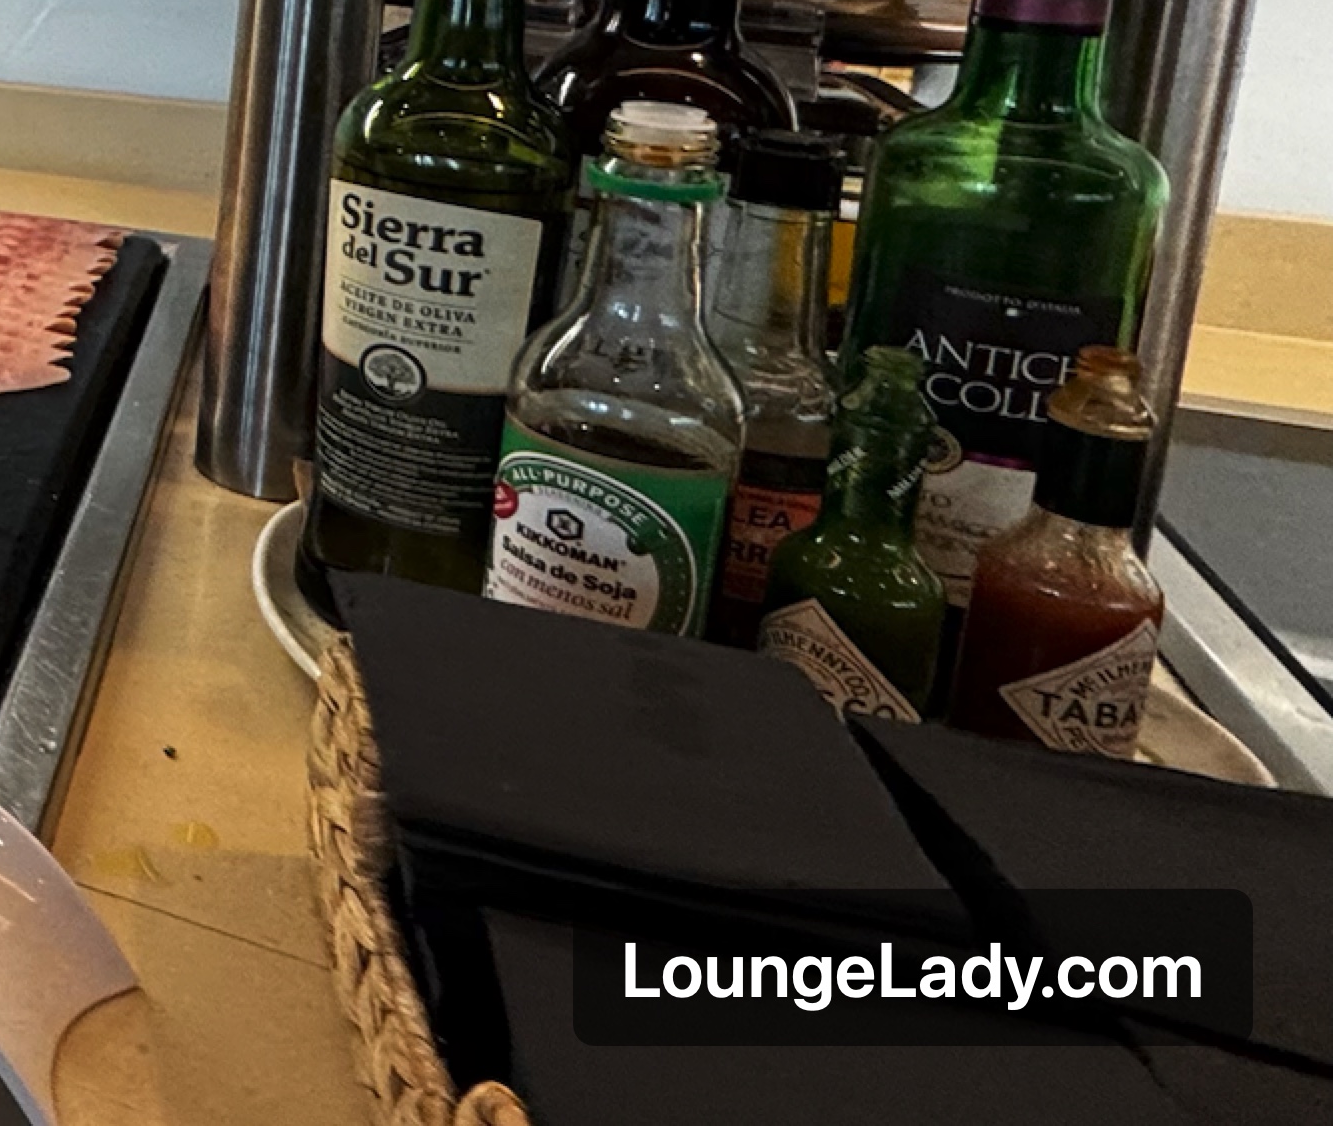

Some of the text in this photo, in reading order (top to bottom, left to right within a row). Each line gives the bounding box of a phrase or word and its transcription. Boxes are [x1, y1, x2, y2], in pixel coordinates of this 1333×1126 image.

[340, 191, 486, 259] Sierra
[342, 233, 484, 298] del Sur
[339, 279, 477, 325] ACEITE DE OLIVA
[343, 296, 463, 338] VIRGEN EXTRA
[904, 326, 1081, 387] ANTICH
[925, 372, 1050, 424] COLL
[499, 557, 526, 585] con
[527, 574, 596, 612] menos
[597, 600, 634, 621] sal
[501, 534, 547, 573] Salsa
[550, 564, 579, 585] de
[583, 573, 638, 601] Soja
[1033, 687, 1139, 729] TABA
